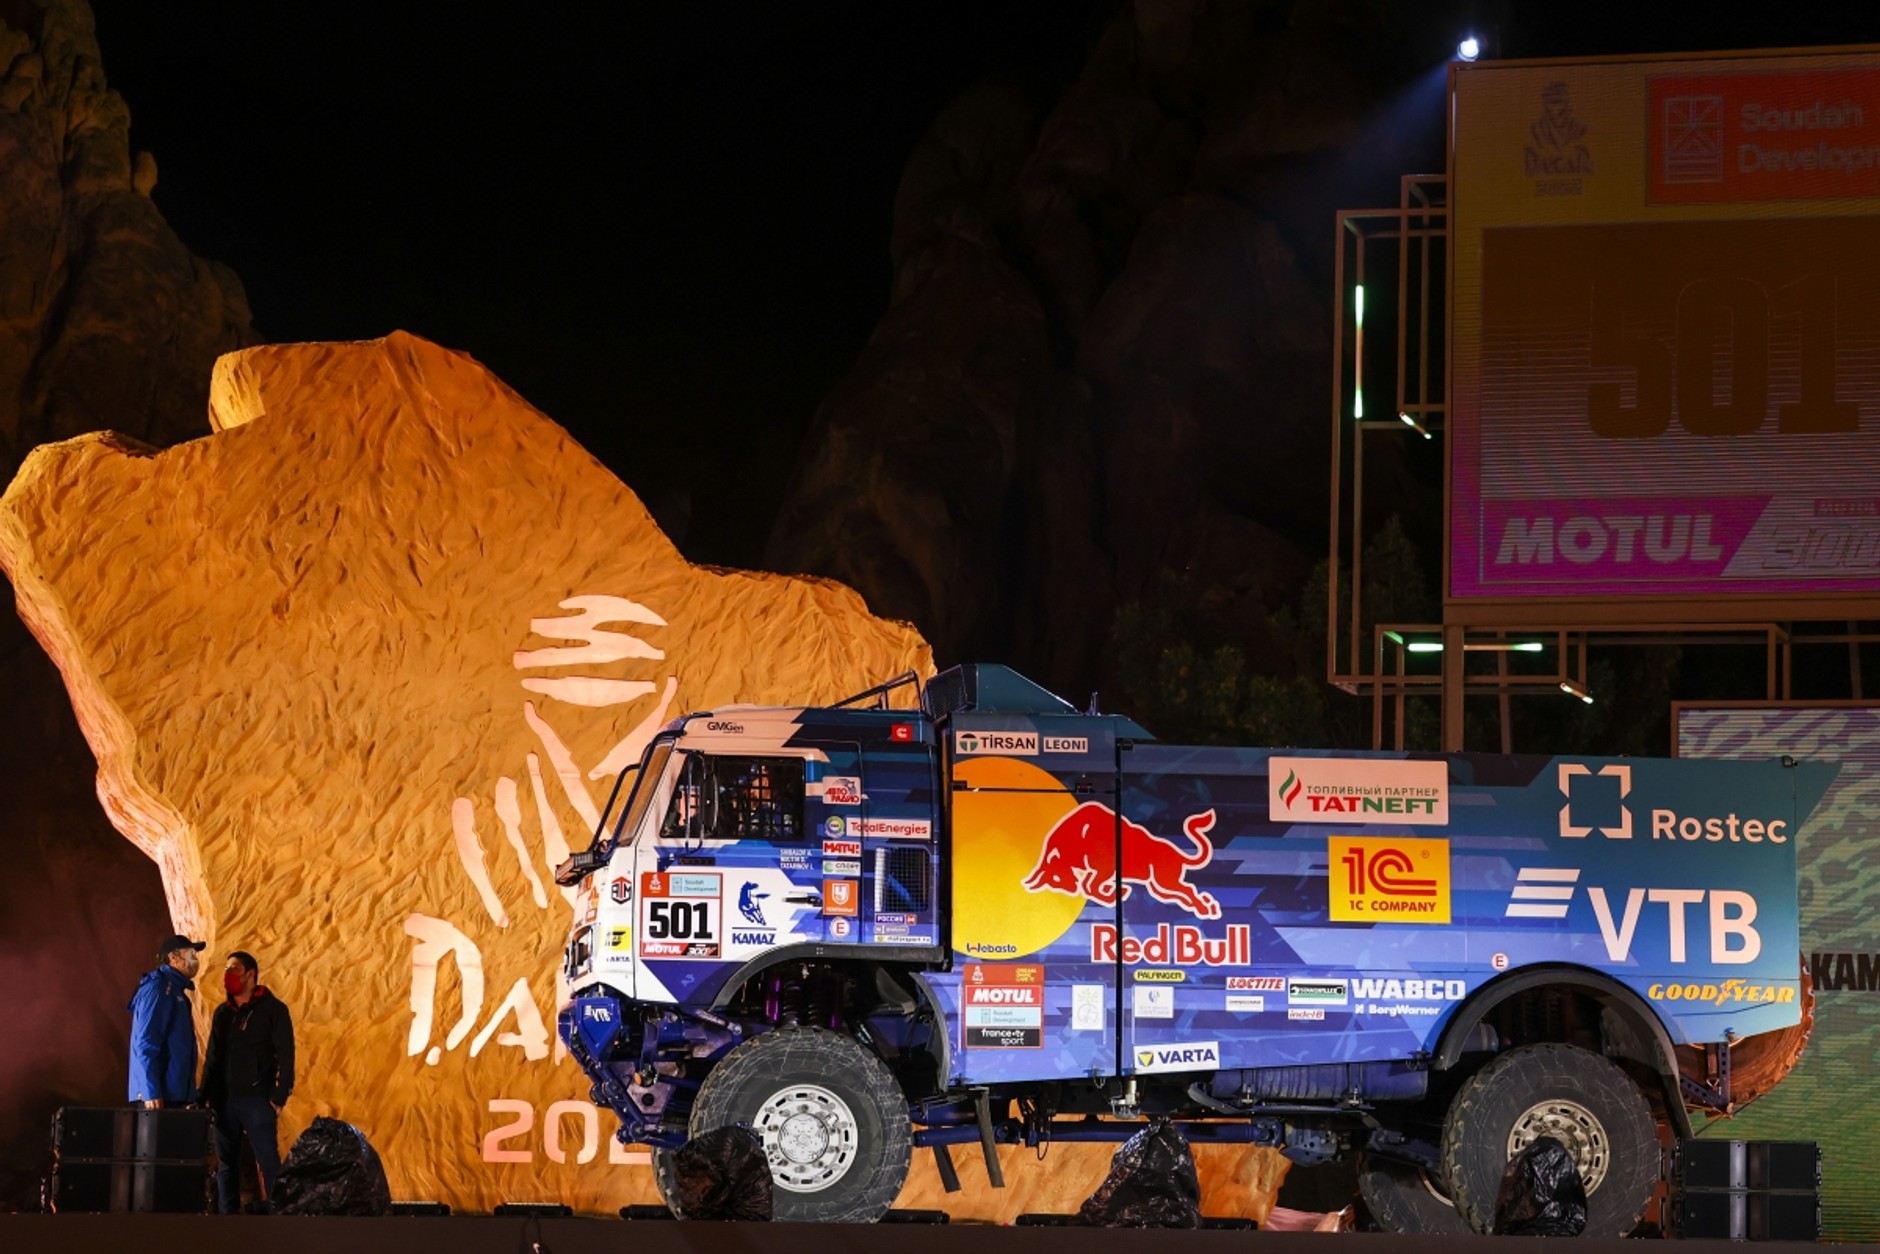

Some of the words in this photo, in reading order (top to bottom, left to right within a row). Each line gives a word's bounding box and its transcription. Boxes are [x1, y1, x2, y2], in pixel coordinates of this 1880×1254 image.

[1740, 101, 1864, 132] Soudah
[1588, 275, 1860, 440] 501
[1495, 515, 1723, 565] MOTUL
[1045, 739, 1086, 750] LEONI
[1307, 784, 1382, 796] ТОПЛИВНЫЙ
[1385, 787, 1439, 797] ПАРТНЕР
[1306, 795, 1440, 815] TATNEFT
[850, 821, 928, 836] TotalEnergies
[1651, 809, 1788, 843] Rostec
[1349, 901, 1364, 911] 1C
[1371, 901, 1437, 912] COMPANY
[649, 901, 713, 940] 501
[1586, 887, 1763, 965] VTB
[732, 932, 776, 946] KAMAZ
[1091, 923, 1170, 964] Red
[1175, 924, 1251, 966] Bull
[644, 943, 682, 955] MOTUL
[1228, 978, 1284, 990] LOCTITE
[1351, 979, 1466, 1000] WABCO
[1647, 979, 1794, 1006] GOODYEAR
[973, 988, 1034, 1004] MOTUL
[1368, 1004, 1440, 1016] BorgWarner
[1158, 1049, 1216, 1064] VARTA
